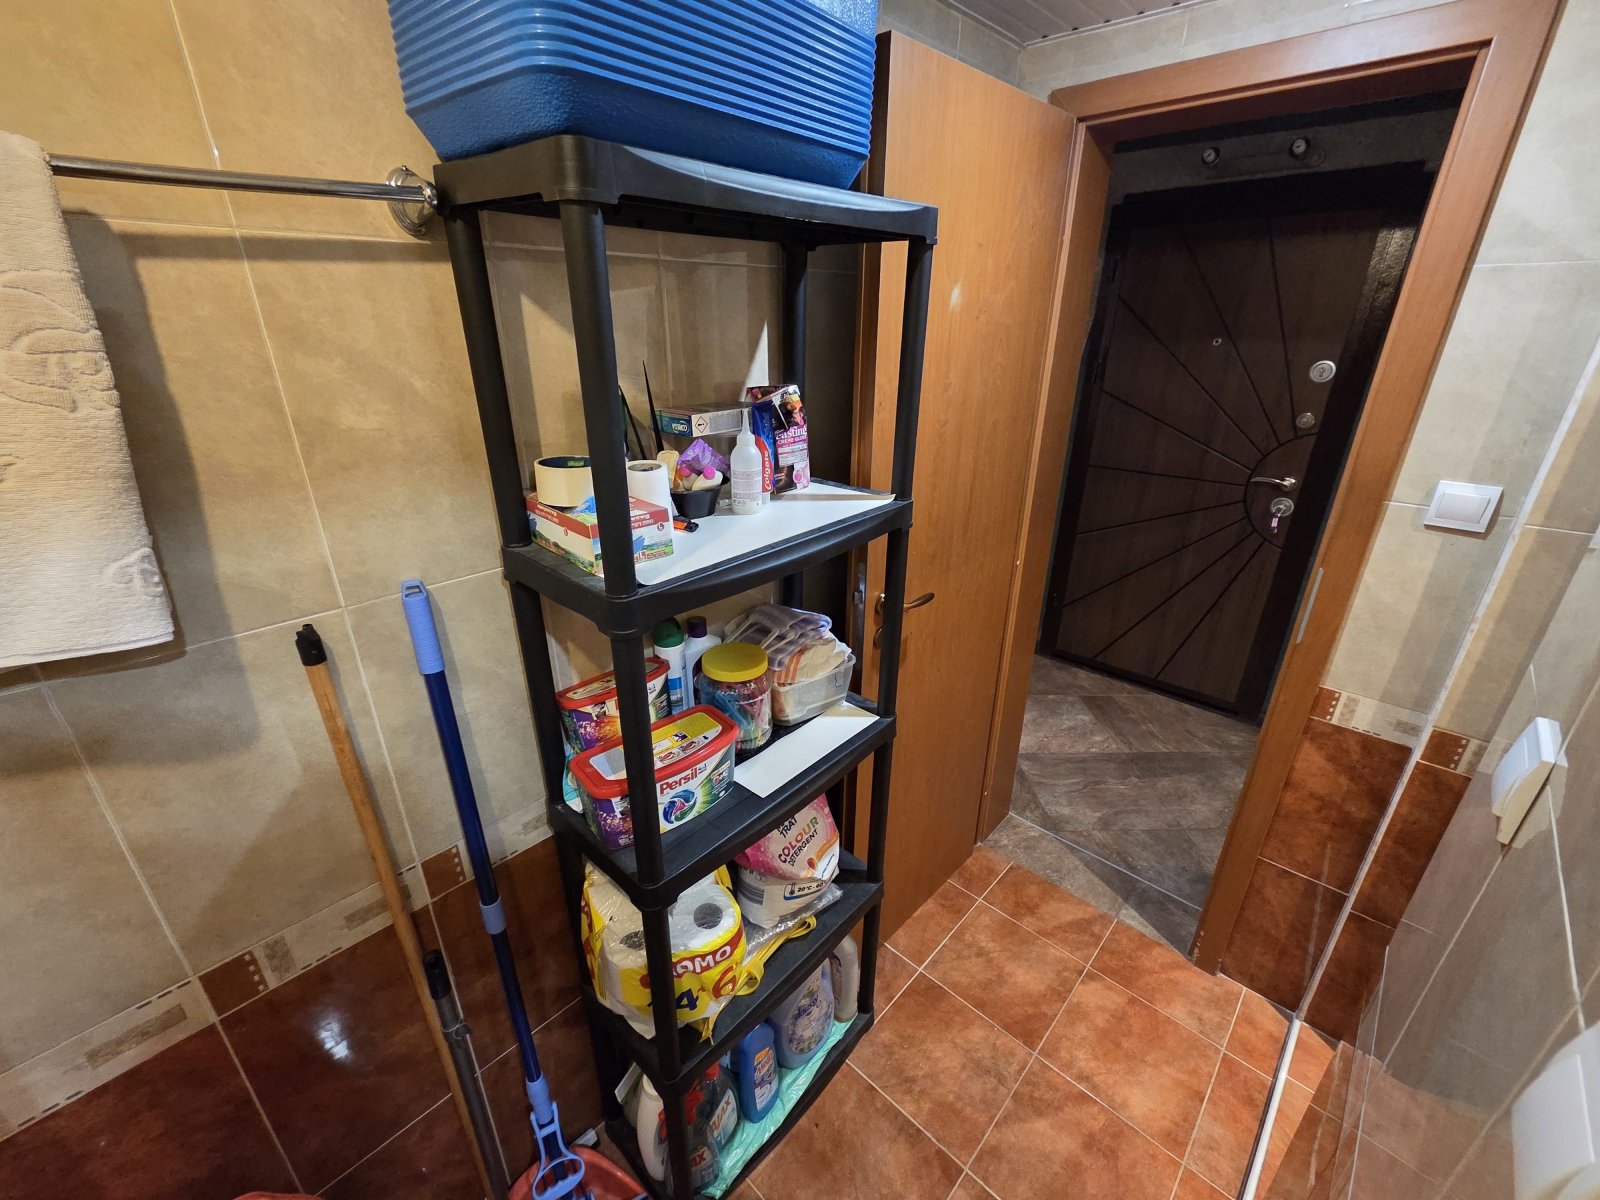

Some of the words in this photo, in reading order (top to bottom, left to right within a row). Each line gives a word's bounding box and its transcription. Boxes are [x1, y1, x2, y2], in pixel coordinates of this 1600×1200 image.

[764, 450, 772, 491] Colgate
[659, 766, 698, 796] Persil
[778, 816, 820, 864] COLOUR
[787, 828, 819, 867] DETERGENT
